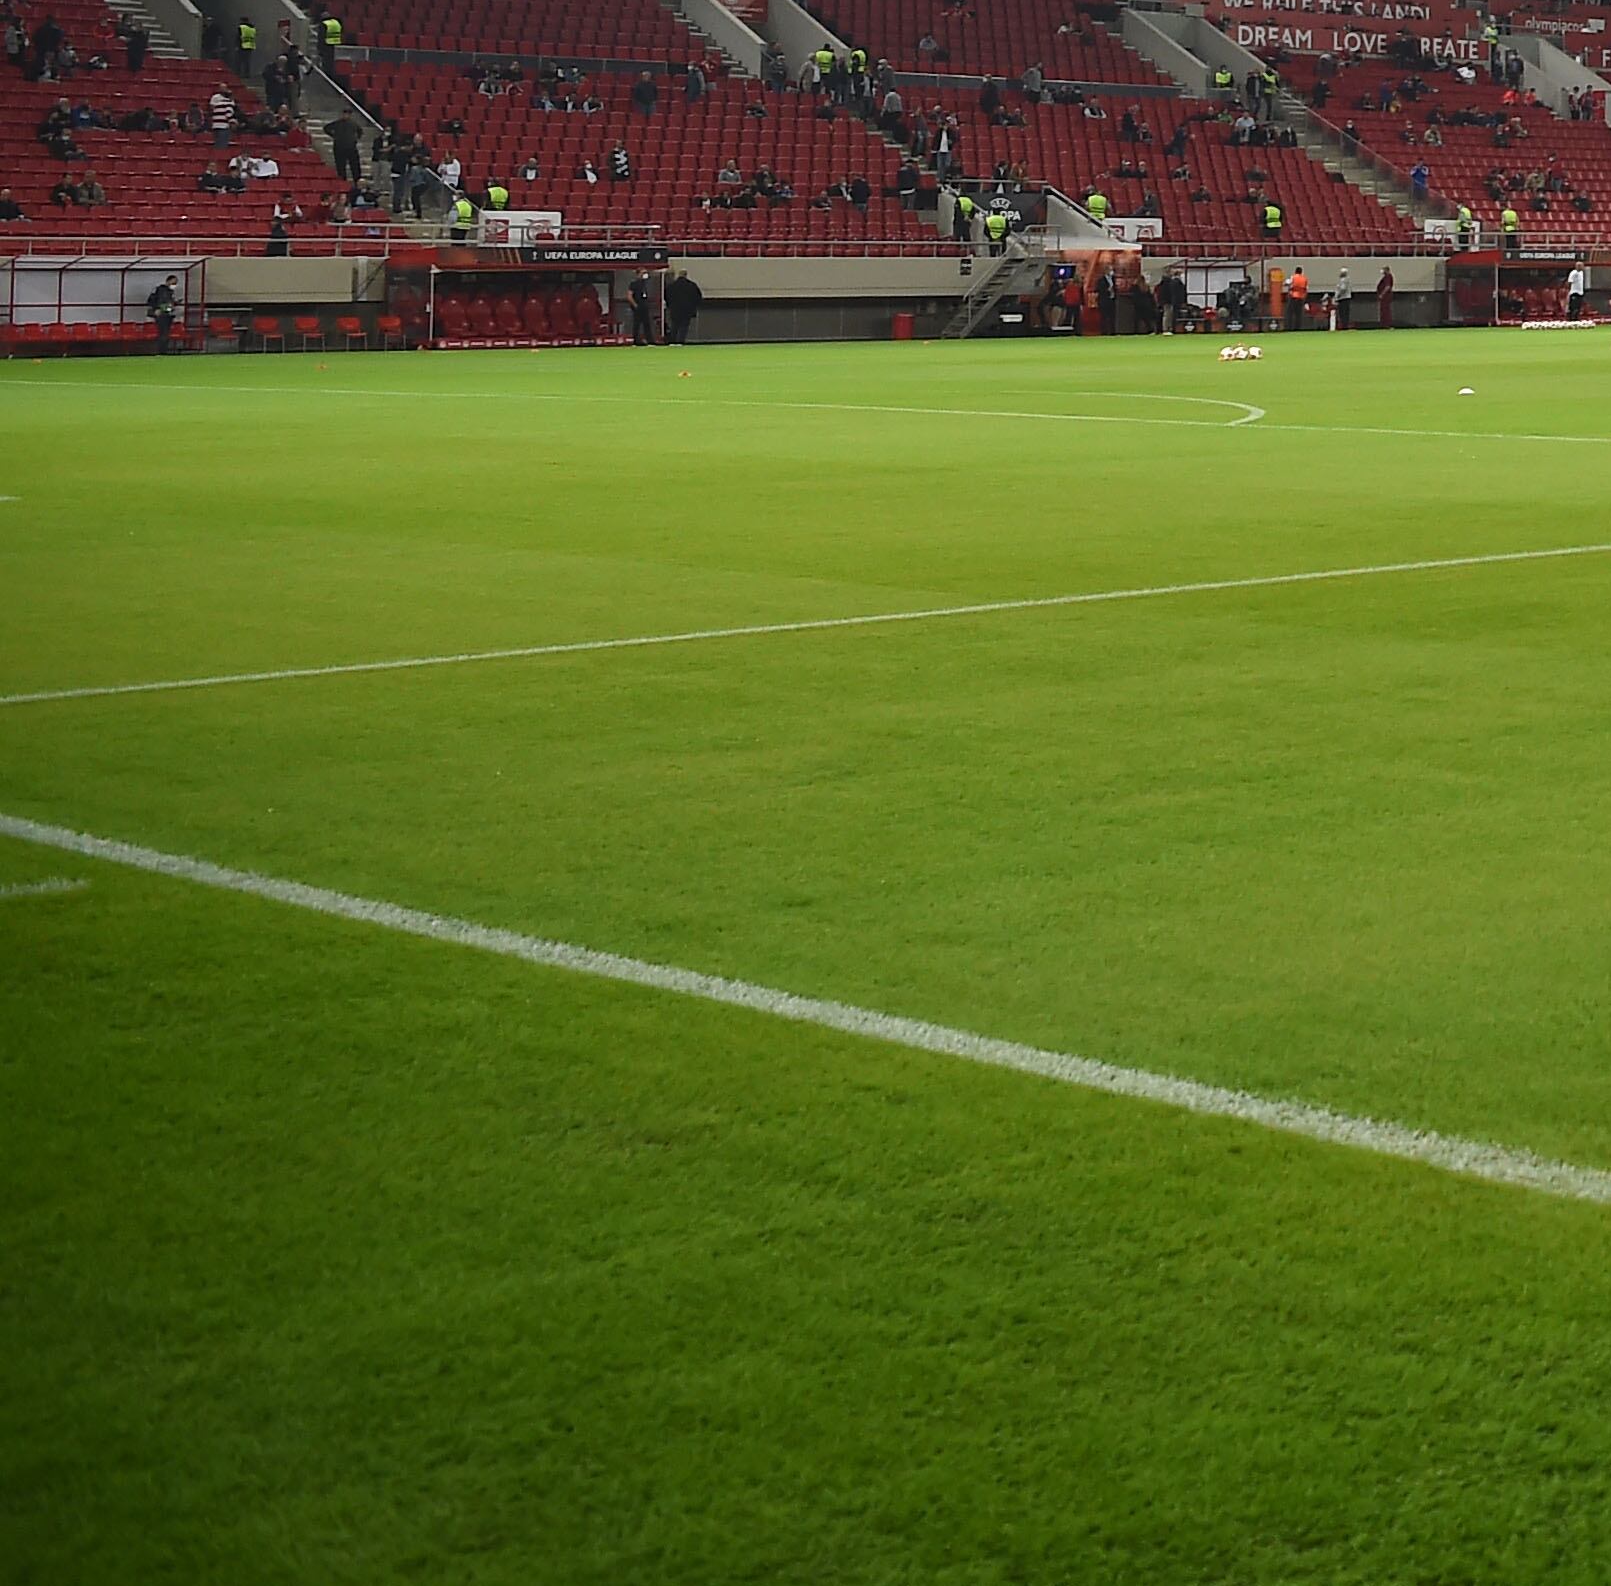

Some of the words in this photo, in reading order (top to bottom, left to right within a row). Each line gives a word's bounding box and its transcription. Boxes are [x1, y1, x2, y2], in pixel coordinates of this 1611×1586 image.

[1238, 25, 1312, 50] DREAM
[1333, 31, 1387, 54] LOVE
[544, 251, 568, 260] UEFA
[570, 251, 603, 260] EUROPA
[605, 251, 639, 260] LEAGUE
